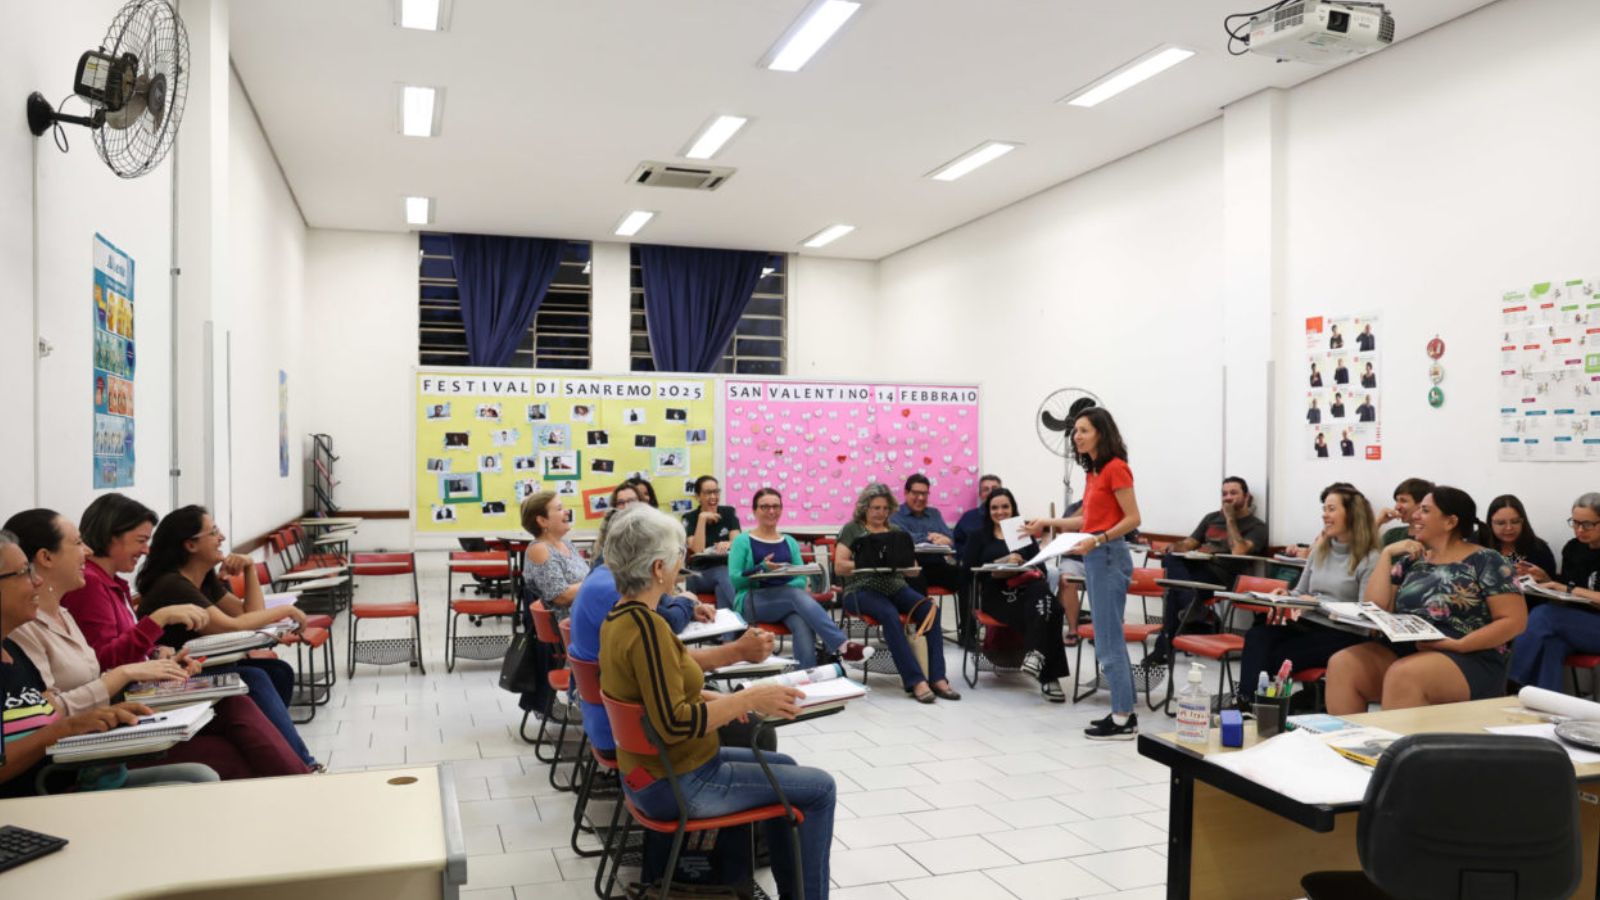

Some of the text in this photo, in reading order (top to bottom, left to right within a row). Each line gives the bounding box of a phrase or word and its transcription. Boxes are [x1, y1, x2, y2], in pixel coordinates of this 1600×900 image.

[423, 379, 702, 398] FESTIVAL DI SANREMO 2025
[730, 386, 977, 402] SAN VALENTINO 14 FEBBRAIO
